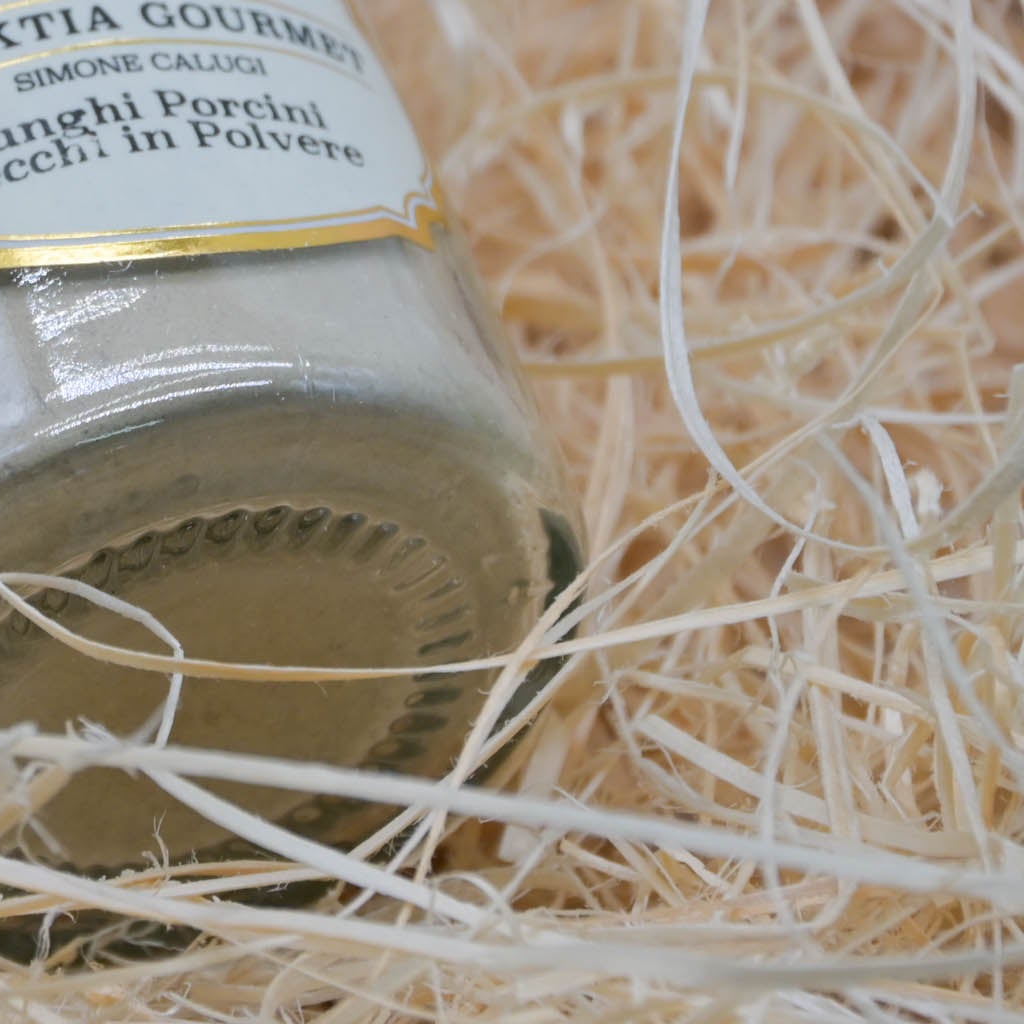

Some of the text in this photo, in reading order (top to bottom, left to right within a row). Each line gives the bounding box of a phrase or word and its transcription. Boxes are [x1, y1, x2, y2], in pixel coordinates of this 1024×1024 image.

[139, 0, 365, 75] GOURMET
[13, 51, 268, 93] SIMONE CALUGI
[153, 88, 328, 130] Porcini
[121, 125, 179, 154] in
[186, 119, 365, 168] Polvere
